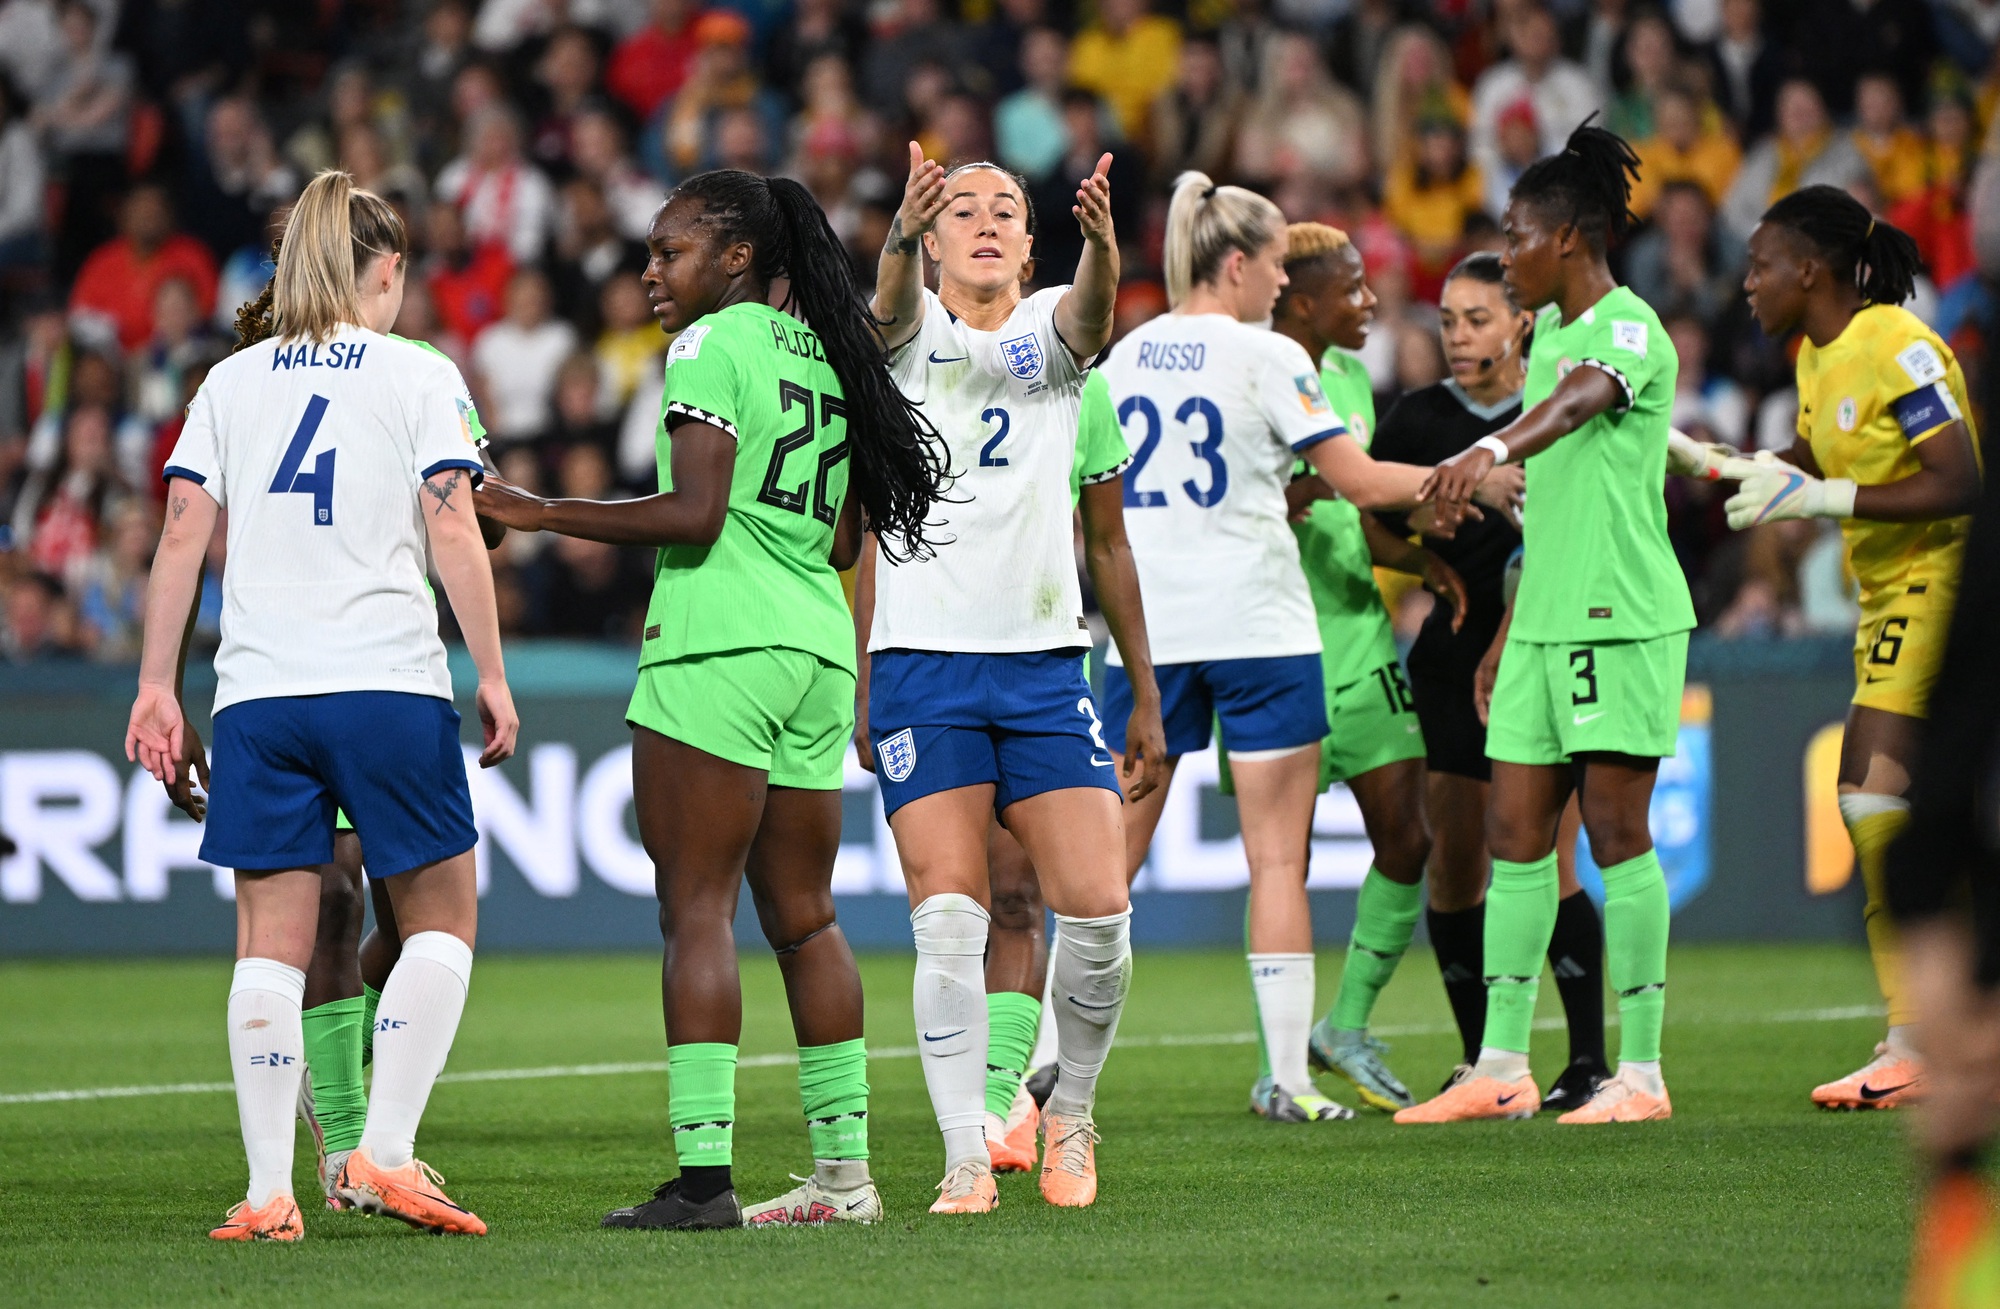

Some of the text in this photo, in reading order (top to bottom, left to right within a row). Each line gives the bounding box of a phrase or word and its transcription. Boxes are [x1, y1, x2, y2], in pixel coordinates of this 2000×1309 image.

[272, 342, 367, 371] WALSH
[769, 319, 827, 363] ALOZ
[1137, 341, 1206, 371] RUSSO
[267, 393, 337, 526] 4
[756, 378, 849, 530] 22
[979, 407, 1009, 467] 2
[1117, 395, 1229, 508] 23
[1569, 648, 1598, 706] 3
[1077, 697, 1107, 750] 2
